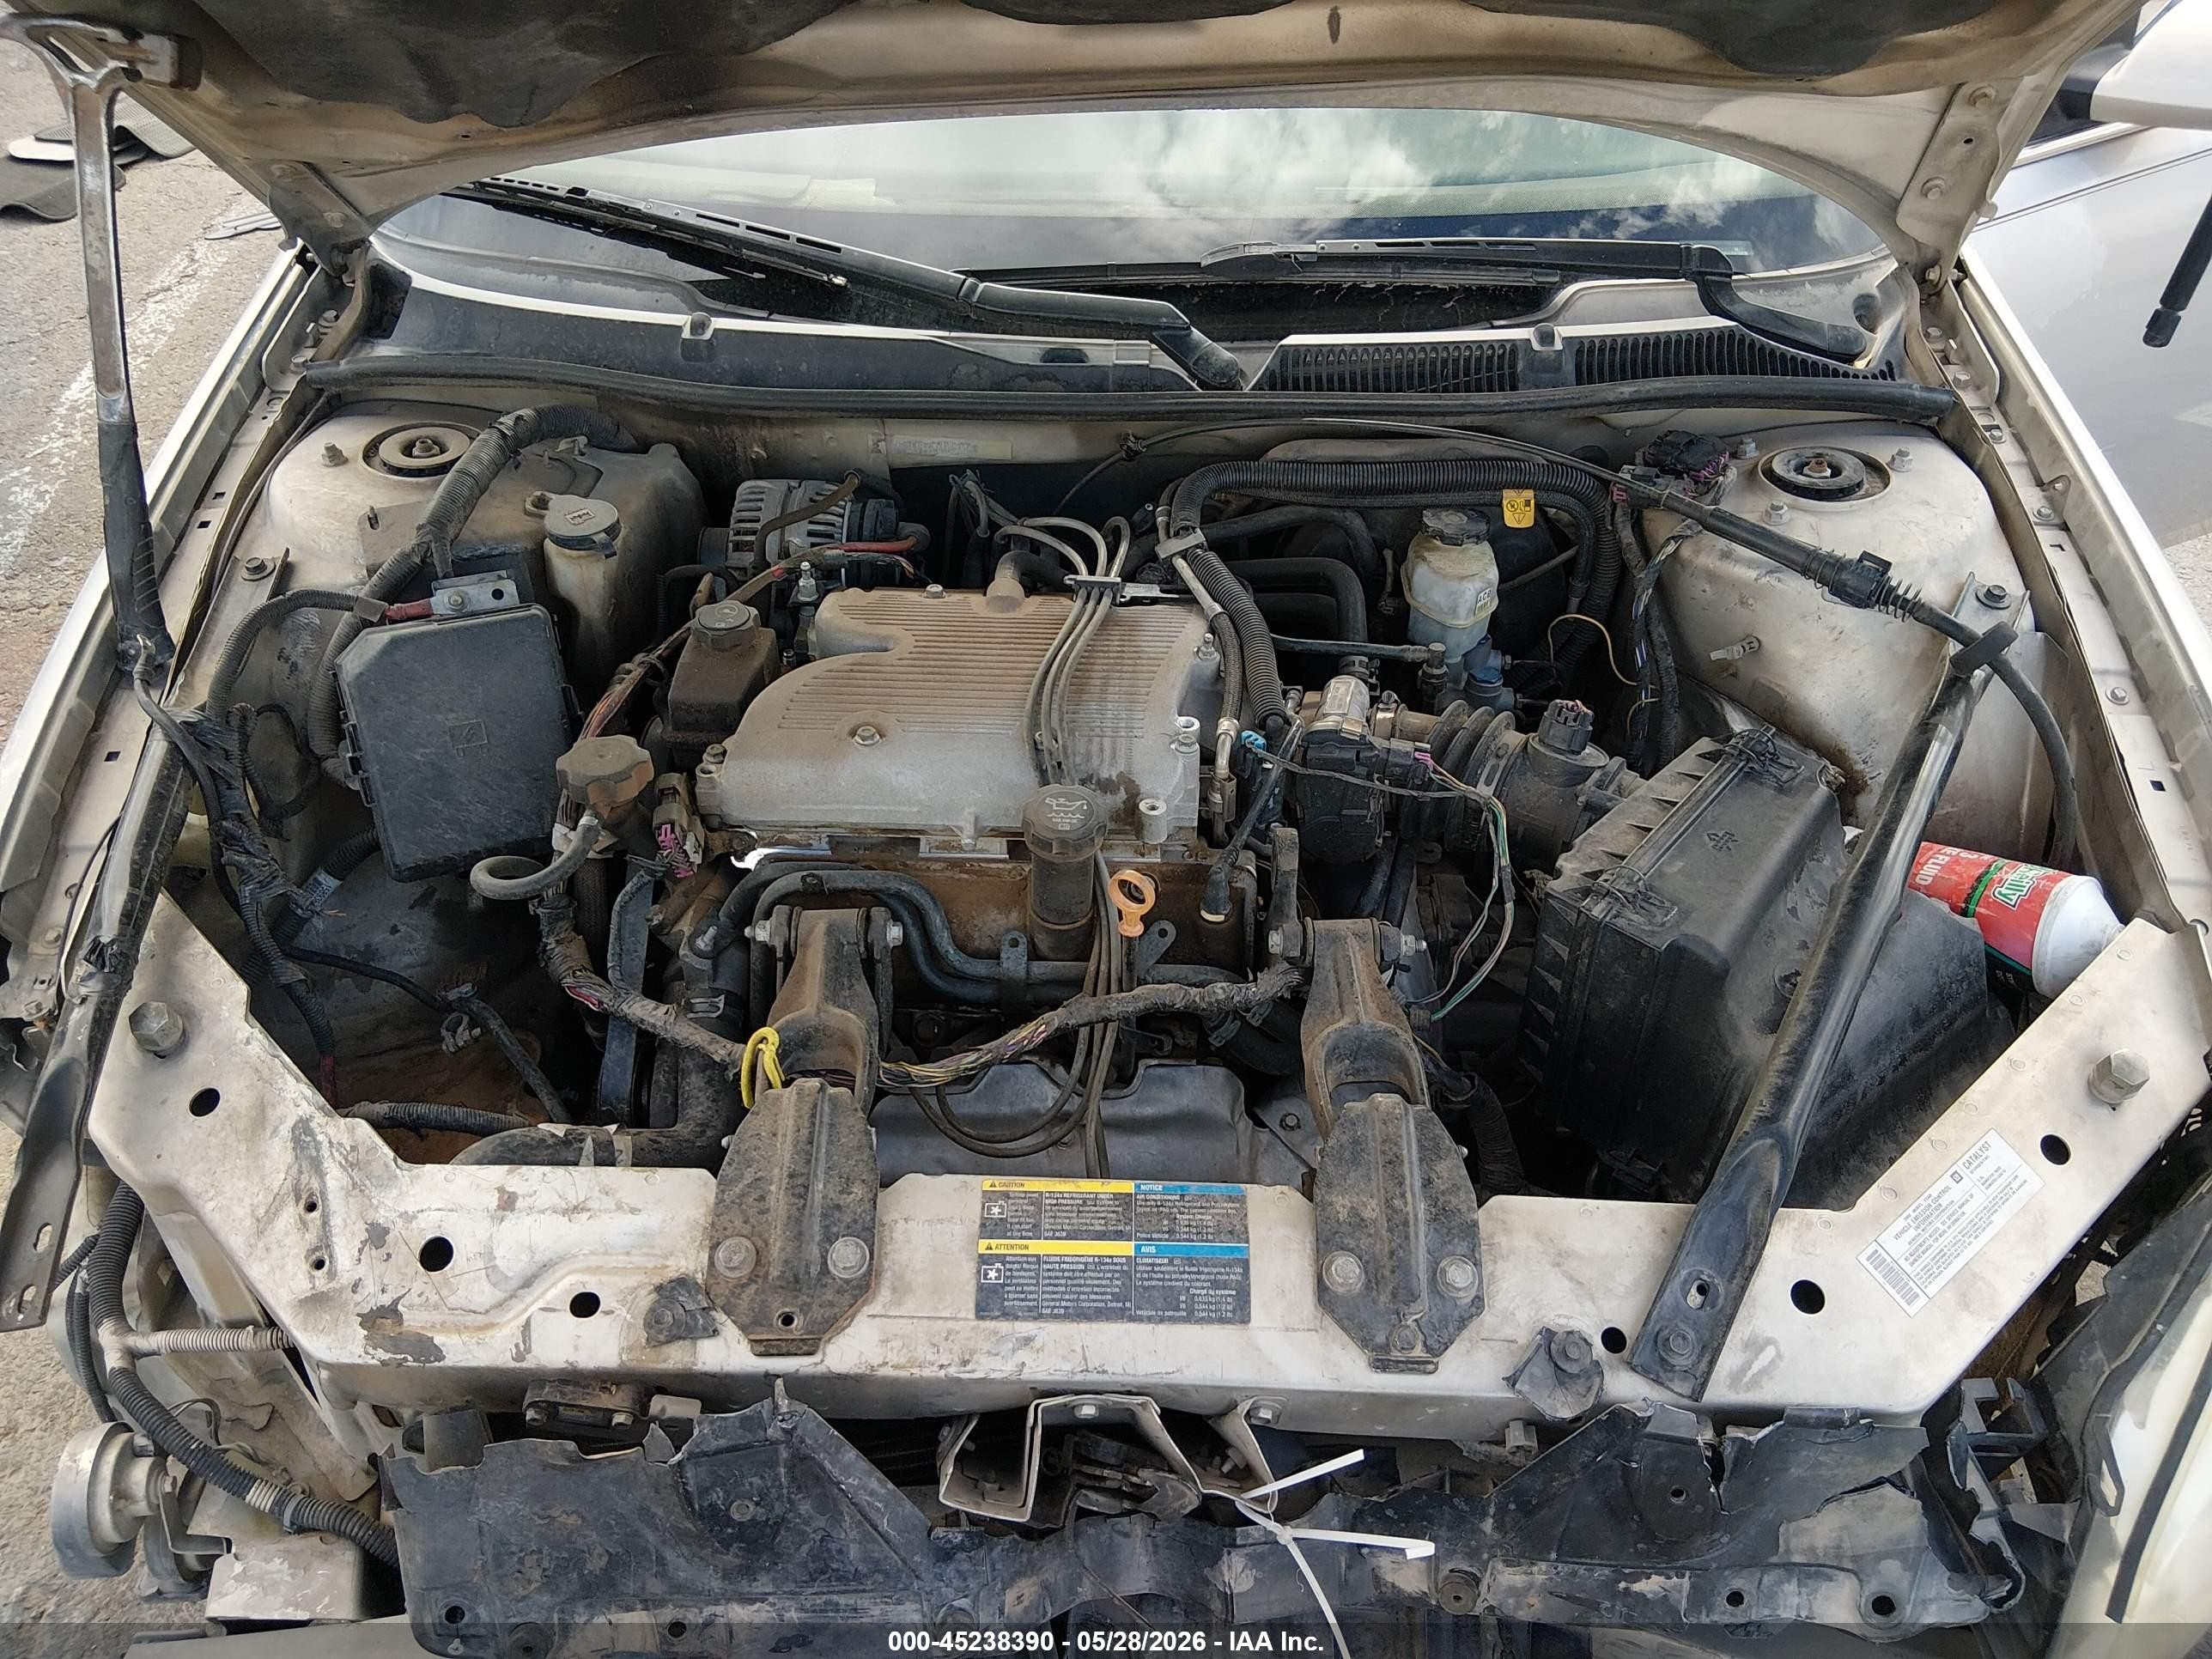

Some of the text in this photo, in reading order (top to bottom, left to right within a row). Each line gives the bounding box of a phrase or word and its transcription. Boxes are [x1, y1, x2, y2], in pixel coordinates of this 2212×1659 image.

[1916, 854, 1951, 885] FLUID
[1962, 1140, 1992, 1170] CATALYST
[1893, 1184, 1951, 1240] VEHICLE EMISSION CONTROL
[1913, 1202, 1942, 1231] INFORMATION
